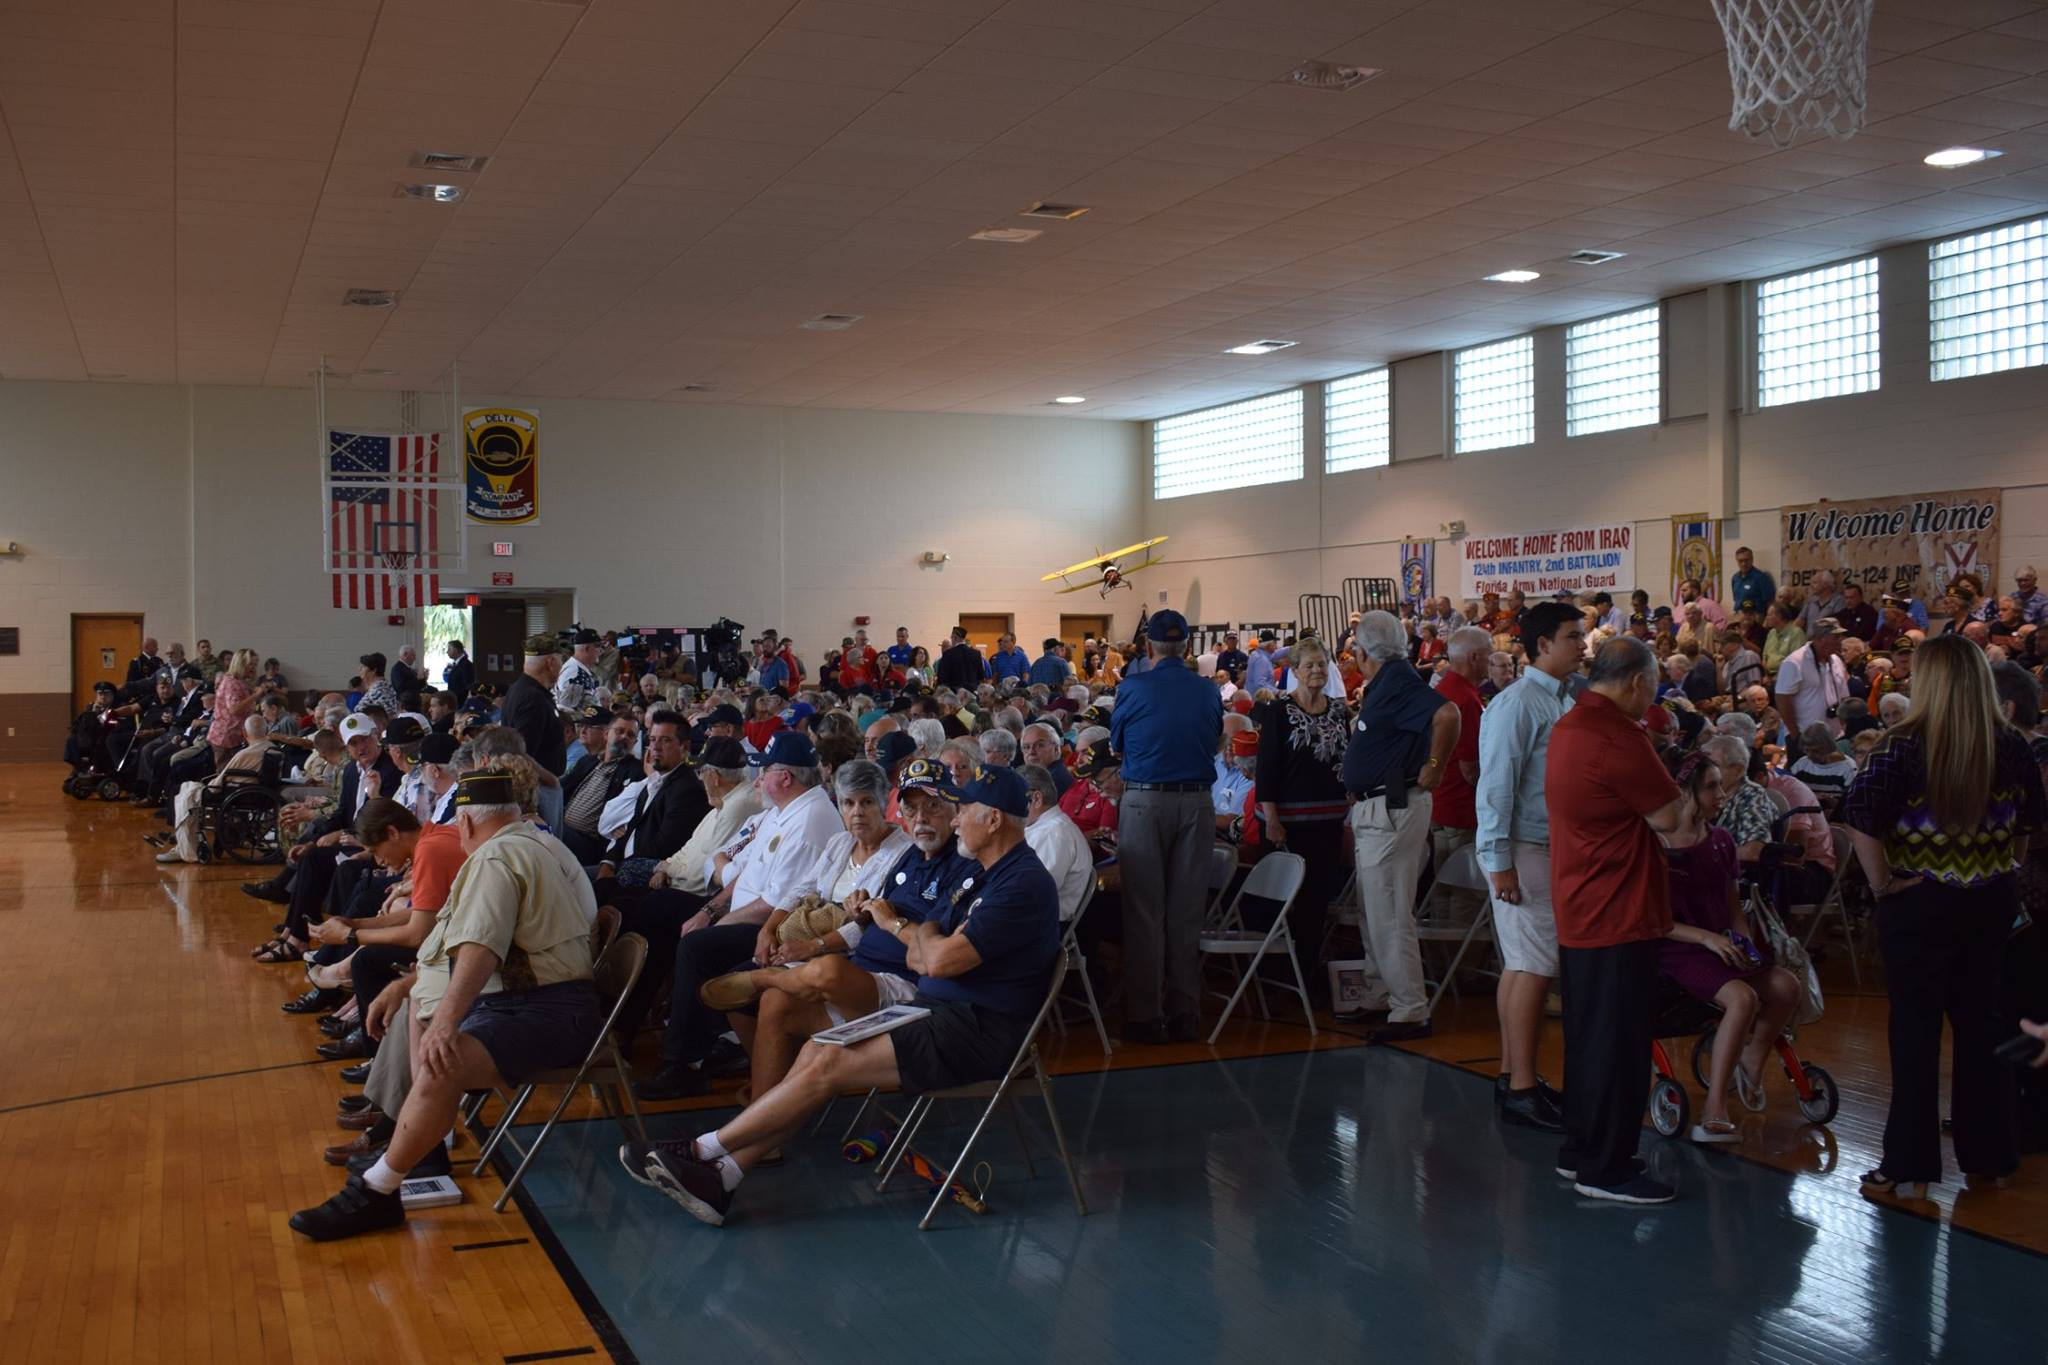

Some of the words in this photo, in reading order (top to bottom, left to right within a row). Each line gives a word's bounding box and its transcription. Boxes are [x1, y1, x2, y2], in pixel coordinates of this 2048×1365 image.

[485, 414, 515, 423] DELTA
[1788, 509, 1904, 542] Welcome
[1909, 501, 1995, 534] Home
[496, 544, 510, 554] EXIT
[1465, 537, 1519, 560] WELCOME
[1523, 534, 1558, 556] HOME
[1560, 530, 1595, 553] FROM
[1599, 526, 1631, 550] IRAQ
[1473, 563, 1496, 576] 124th
[1499, 559, 1543, 575] INFANTRY,
[1545, 557, 1564, 572] 2nd
[1567, 552, 1622, 570] BATTALION
[1843, 566, 1889, 585] 2-124
[1895, 564, 1921, 582] INF
[1475, 580, 1508, 594] Florida
[1512, 579, 1535, 593] Army
[1539, 575, 1582, 591] National
[1585, 572, 1616, 588] Guard
